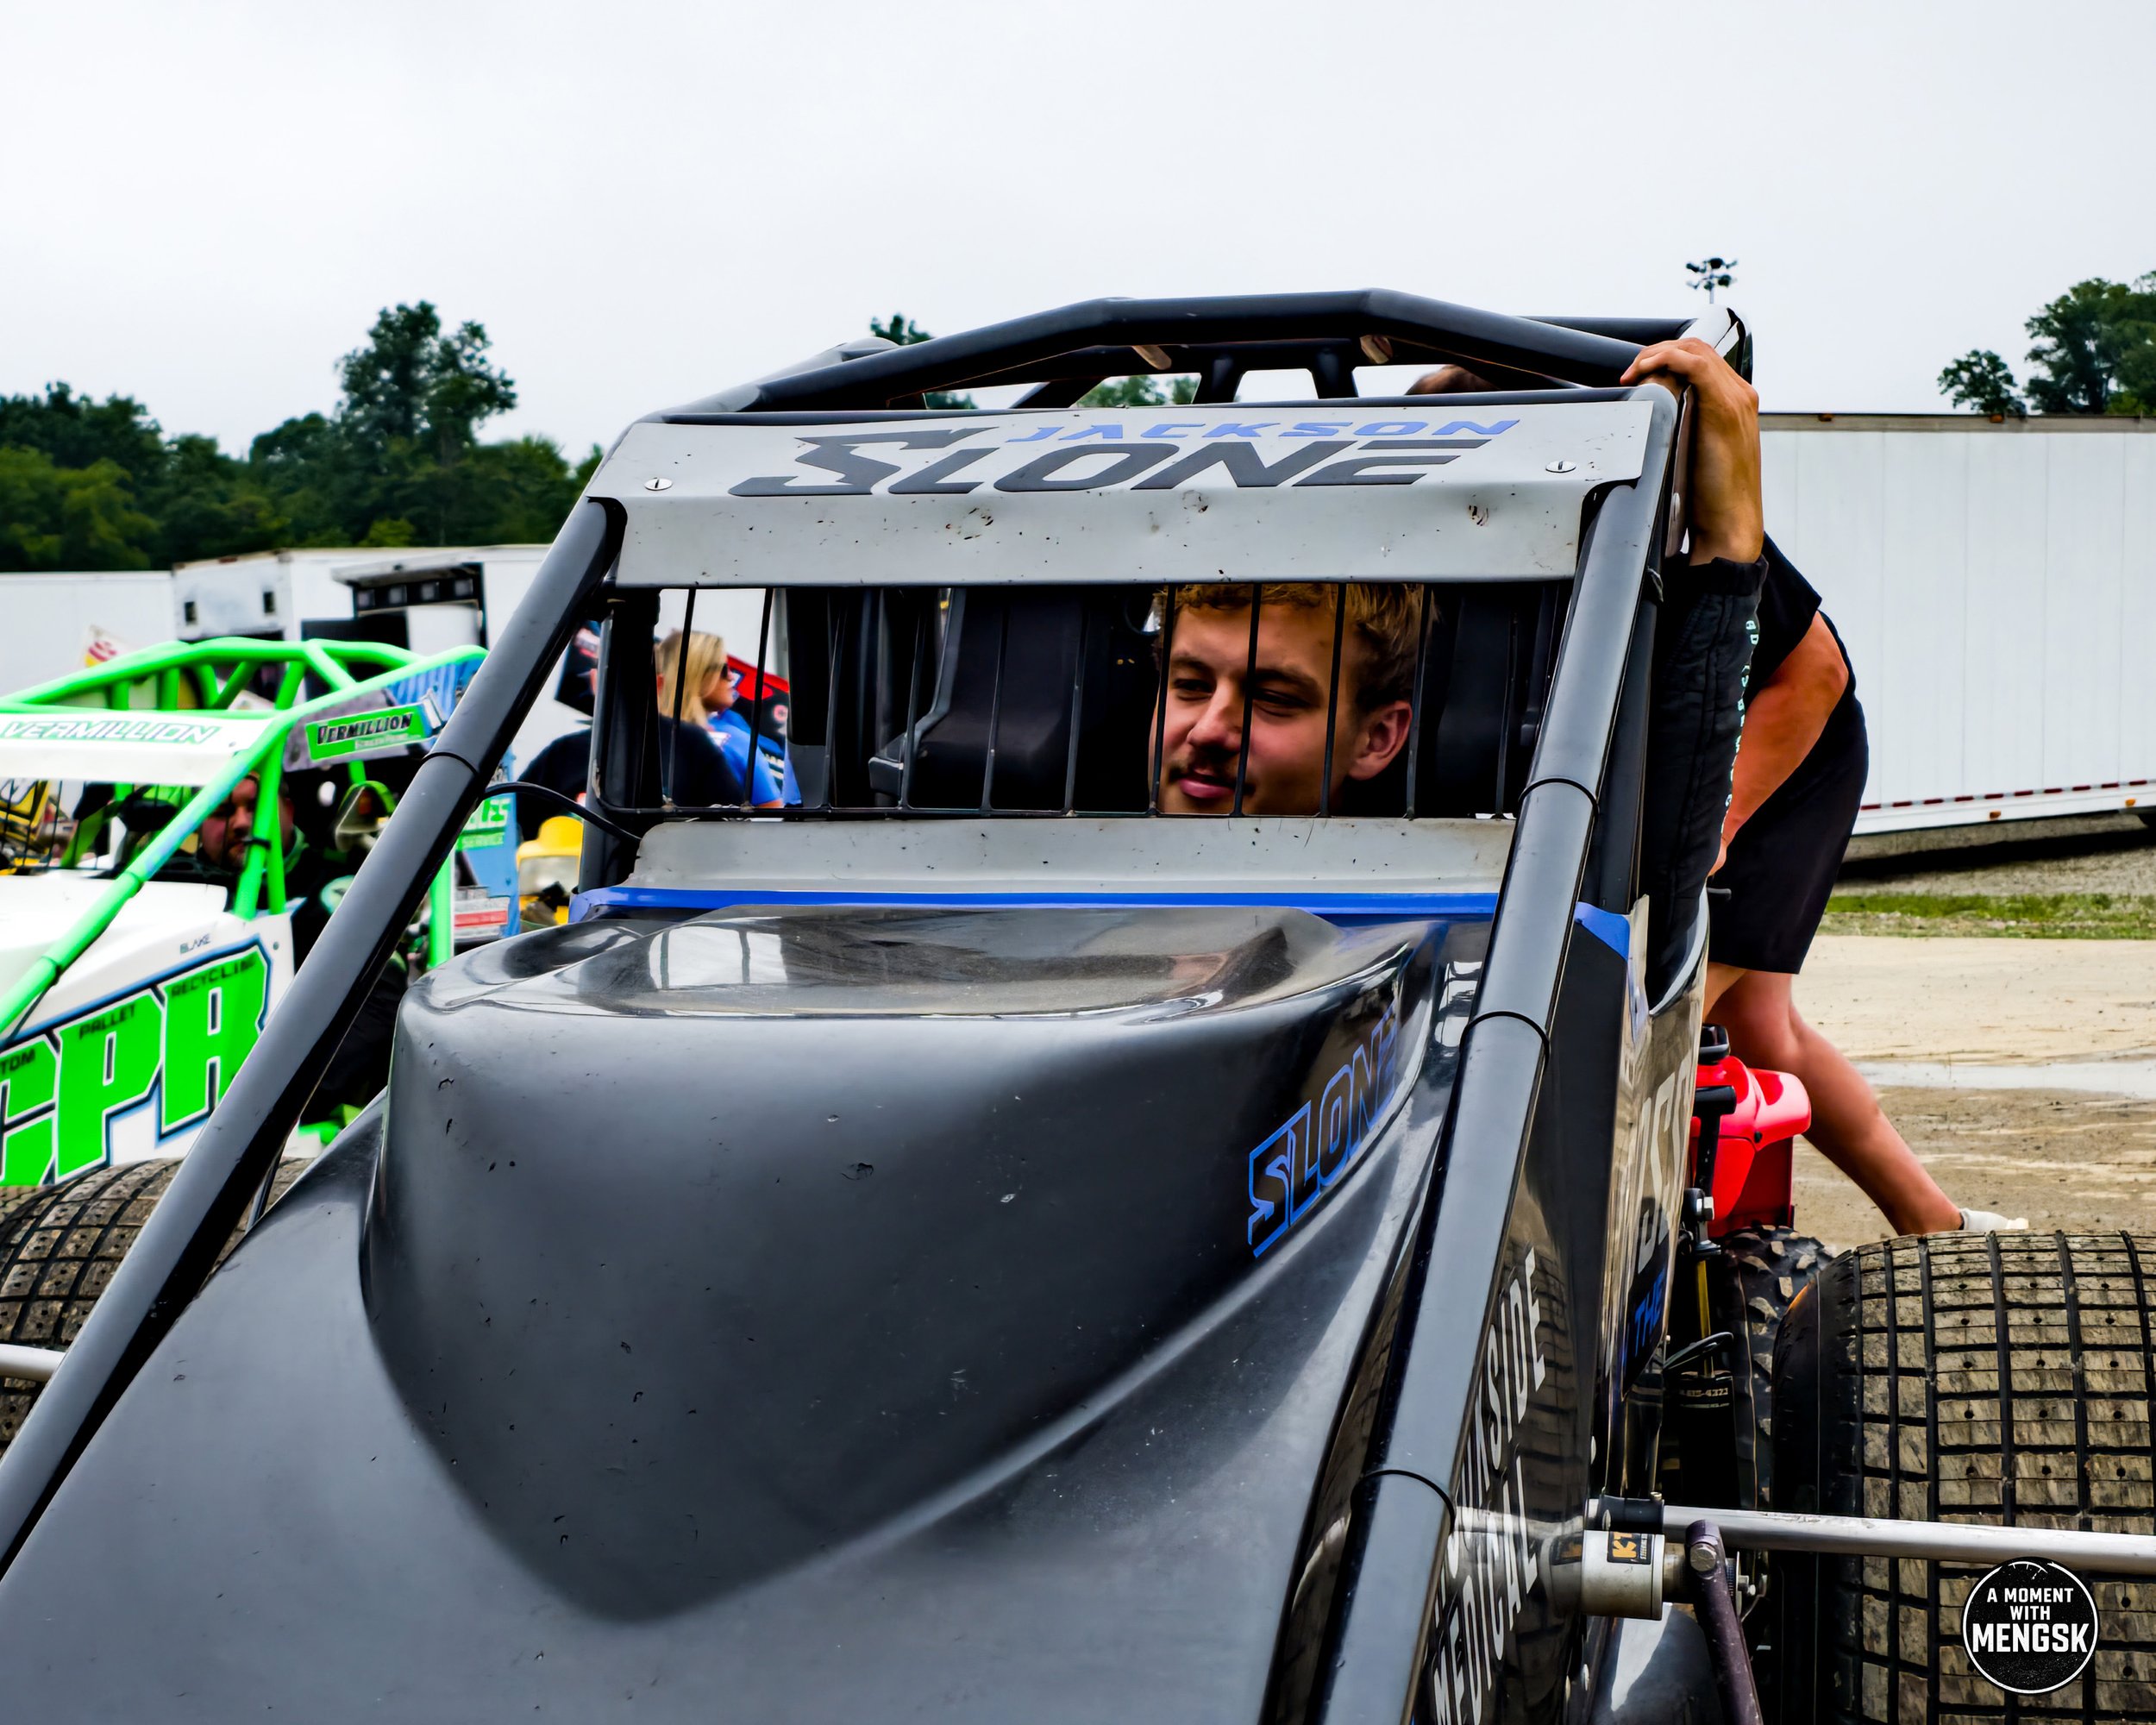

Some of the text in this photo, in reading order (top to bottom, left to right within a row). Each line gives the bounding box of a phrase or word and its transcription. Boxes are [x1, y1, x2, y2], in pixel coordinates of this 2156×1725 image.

[1006, 418, 1520, 443] JACKSON
[727, 427, 1492, 496] SLONE
[1, 720, 222, 744] VERMILLION
[317, 712, 414, 745] VERMILLION
[78, 1003, 136, 1040] PALLET
[1248, 998, 1399, 1258] SLONE
